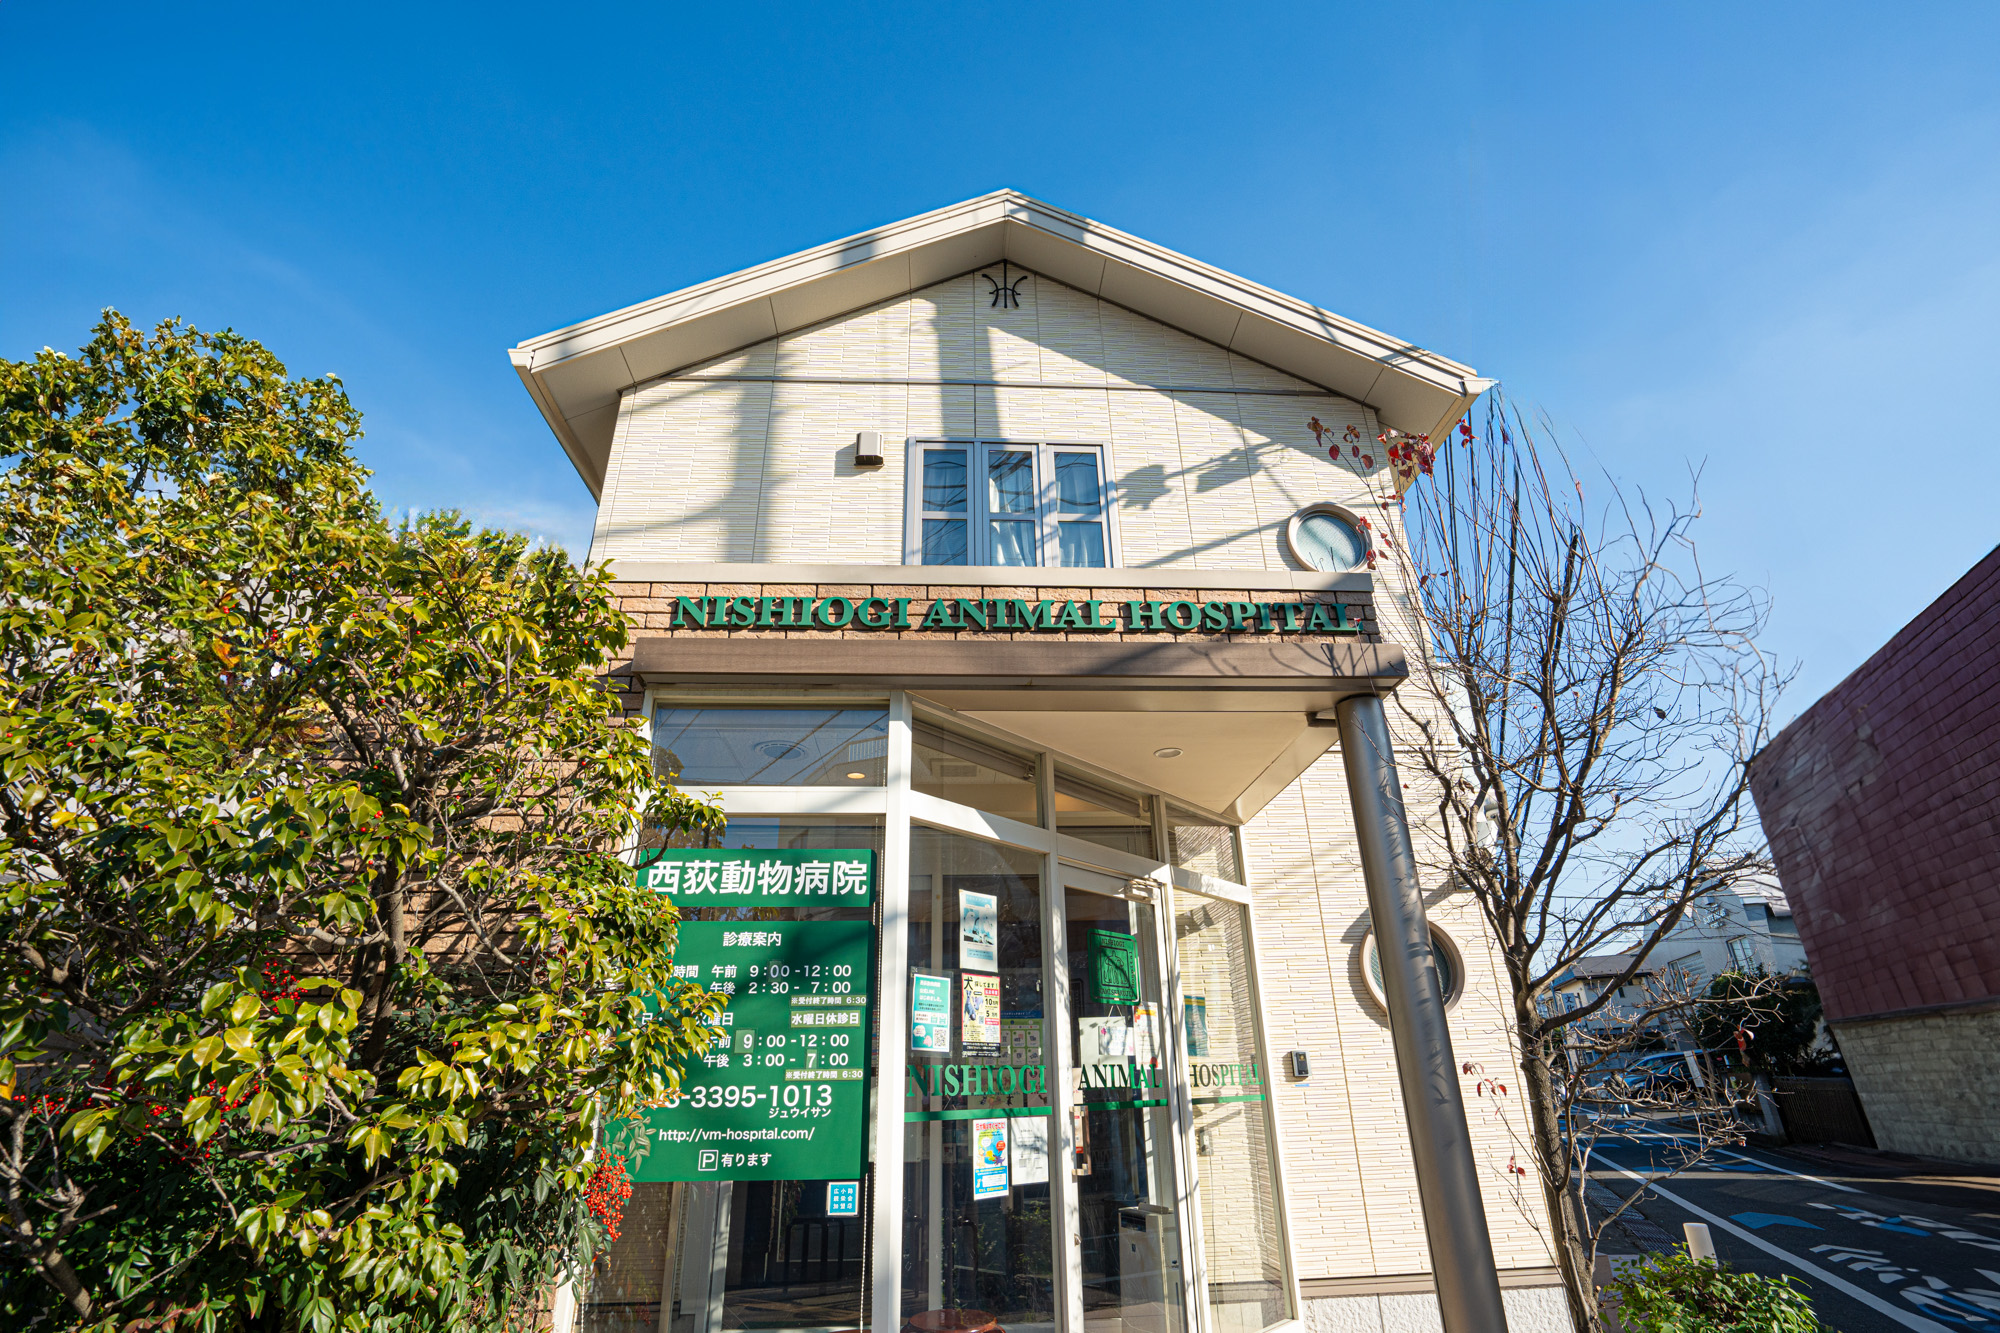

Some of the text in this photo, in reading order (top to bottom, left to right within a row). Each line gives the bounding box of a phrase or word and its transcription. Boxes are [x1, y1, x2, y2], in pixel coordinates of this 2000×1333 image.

[672, 595, 1364, 633] NISHIOGI ANIMAL HOSPITAL
[648, 859, 868, 896] 西荻動物病院
[723, 931, 782, 947] 診療案内
[711, 965, 737, 978] 午前
[710, 981, 736, 995] 午後
[846, 996, 867, 1005] 6:30
[791, 1012, 860, 1026] 水曜日休診日
[703, 1053, 730, 1068] 午後
[842, 1070, 863, 1079] 6:30
[906, 1063, 1264, 1097] NISHIOGI ANIMAL HOSPITAL
[648, 1085, 832, 1109] 3-3395-1013
[768, 1107, 832, 1118] ジュウイサン
[658, 1126, 816, 1143] http://vm-hospital.com/
[721, 1152, 772, 1168] 有ります
